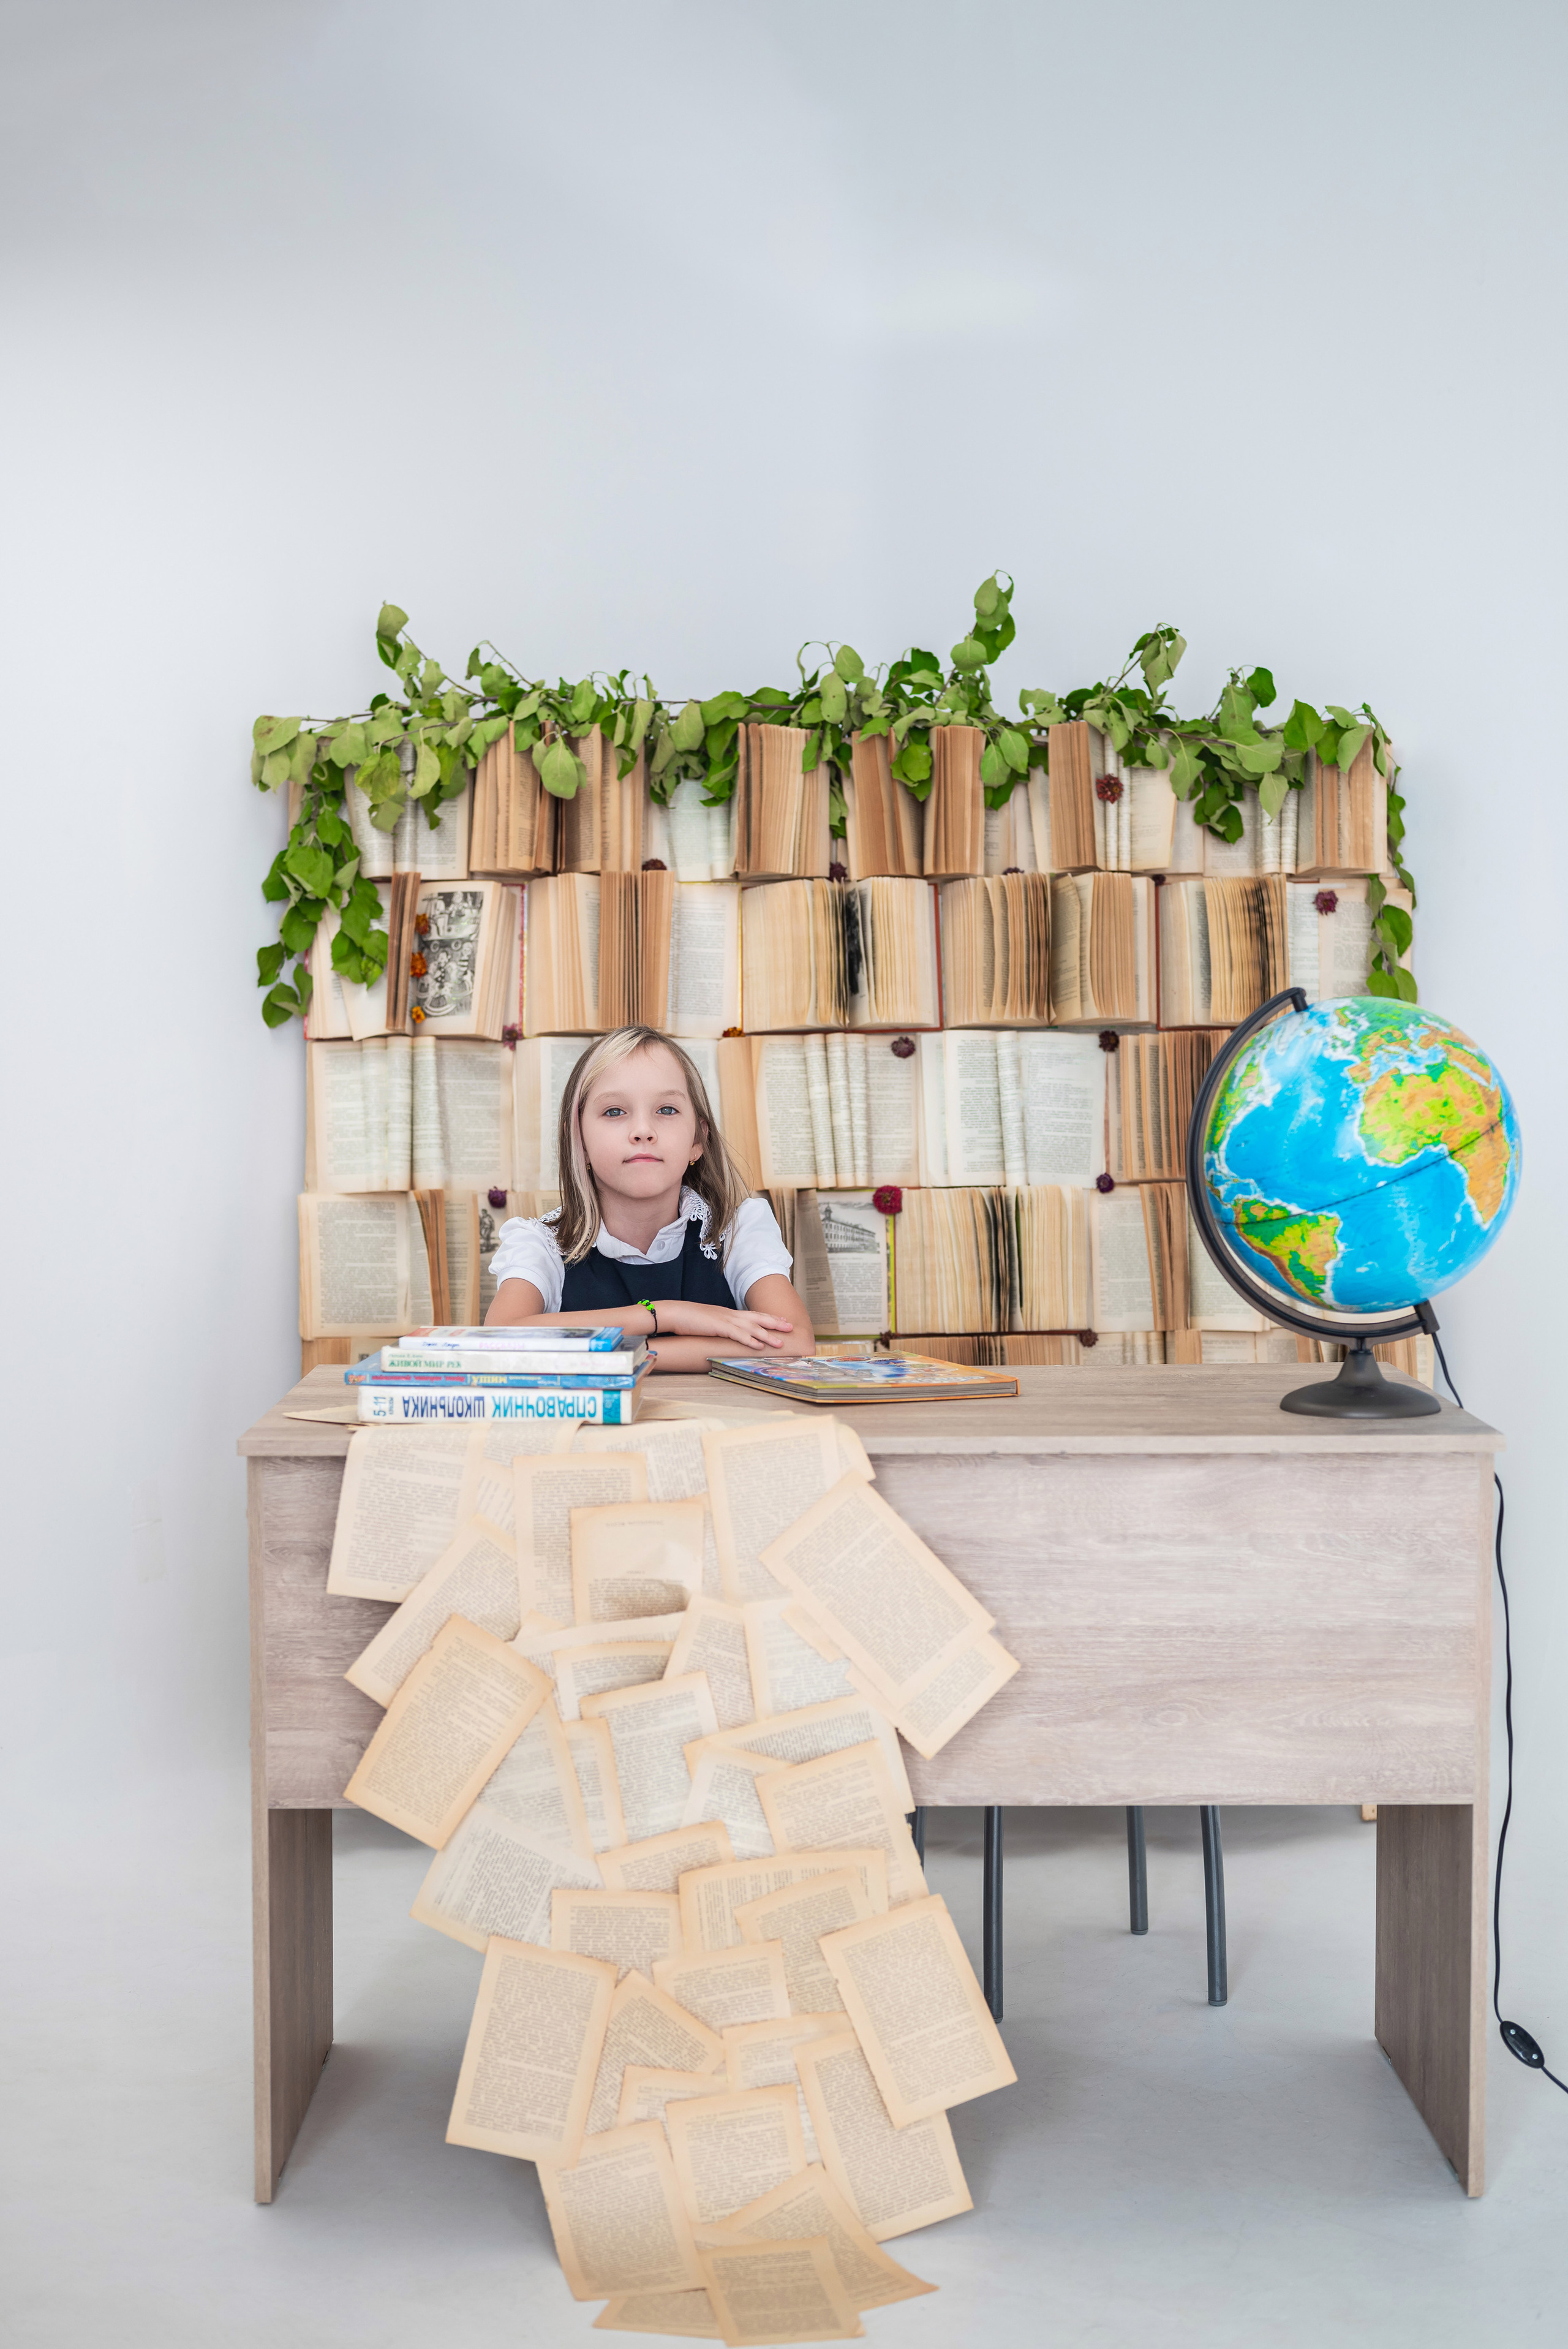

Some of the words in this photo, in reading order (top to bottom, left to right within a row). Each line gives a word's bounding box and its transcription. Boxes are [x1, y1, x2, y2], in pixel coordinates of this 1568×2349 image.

[389, 1360, 421, 1368] ЖИВОЙ
[472, 1375, 507, 1384] МИША
[402, 1396, 484, 1417] ШКОЛЬНИКА
[492, 1396, 597, 1418] СПРАВОЧНИК
